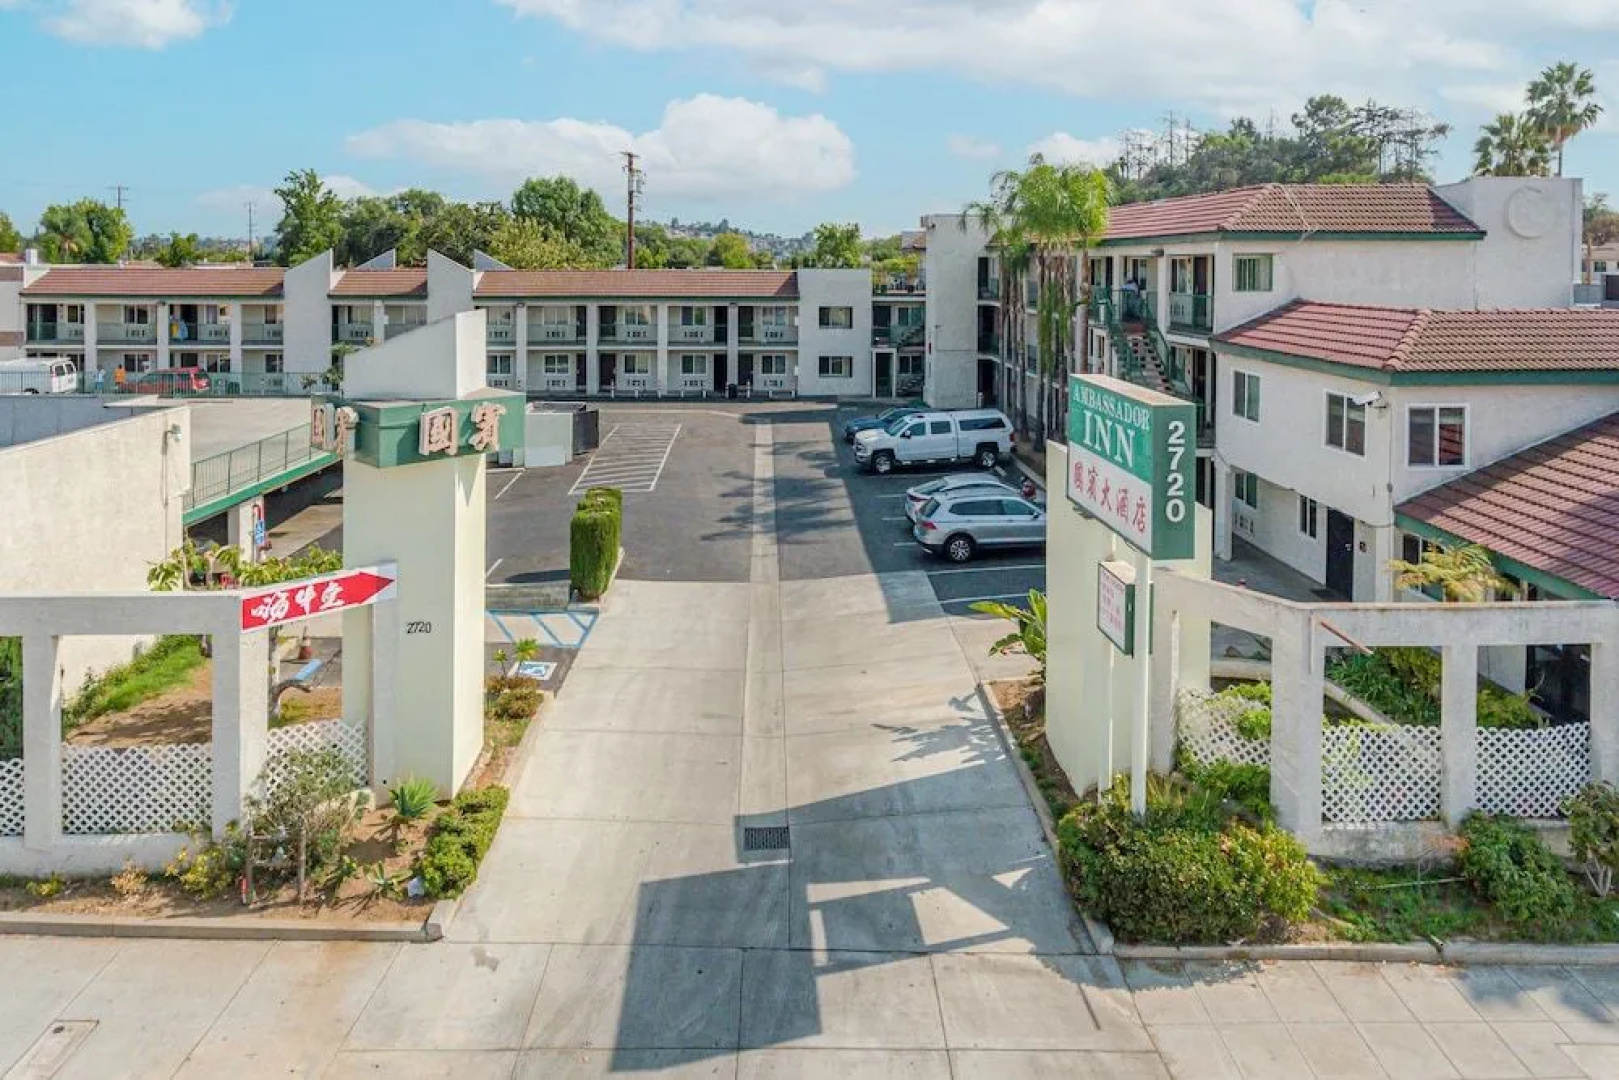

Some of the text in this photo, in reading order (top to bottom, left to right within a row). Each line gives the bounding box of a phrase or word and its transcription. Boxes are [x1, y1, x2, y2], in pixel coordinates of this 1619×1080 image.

[1073, 384, 1150, 430] AMBASSADOR
[1083, 410, 1136, 469] INN
[1166, 420, 1186, 523] 2720
[407, 621, 431, 634] 2720
